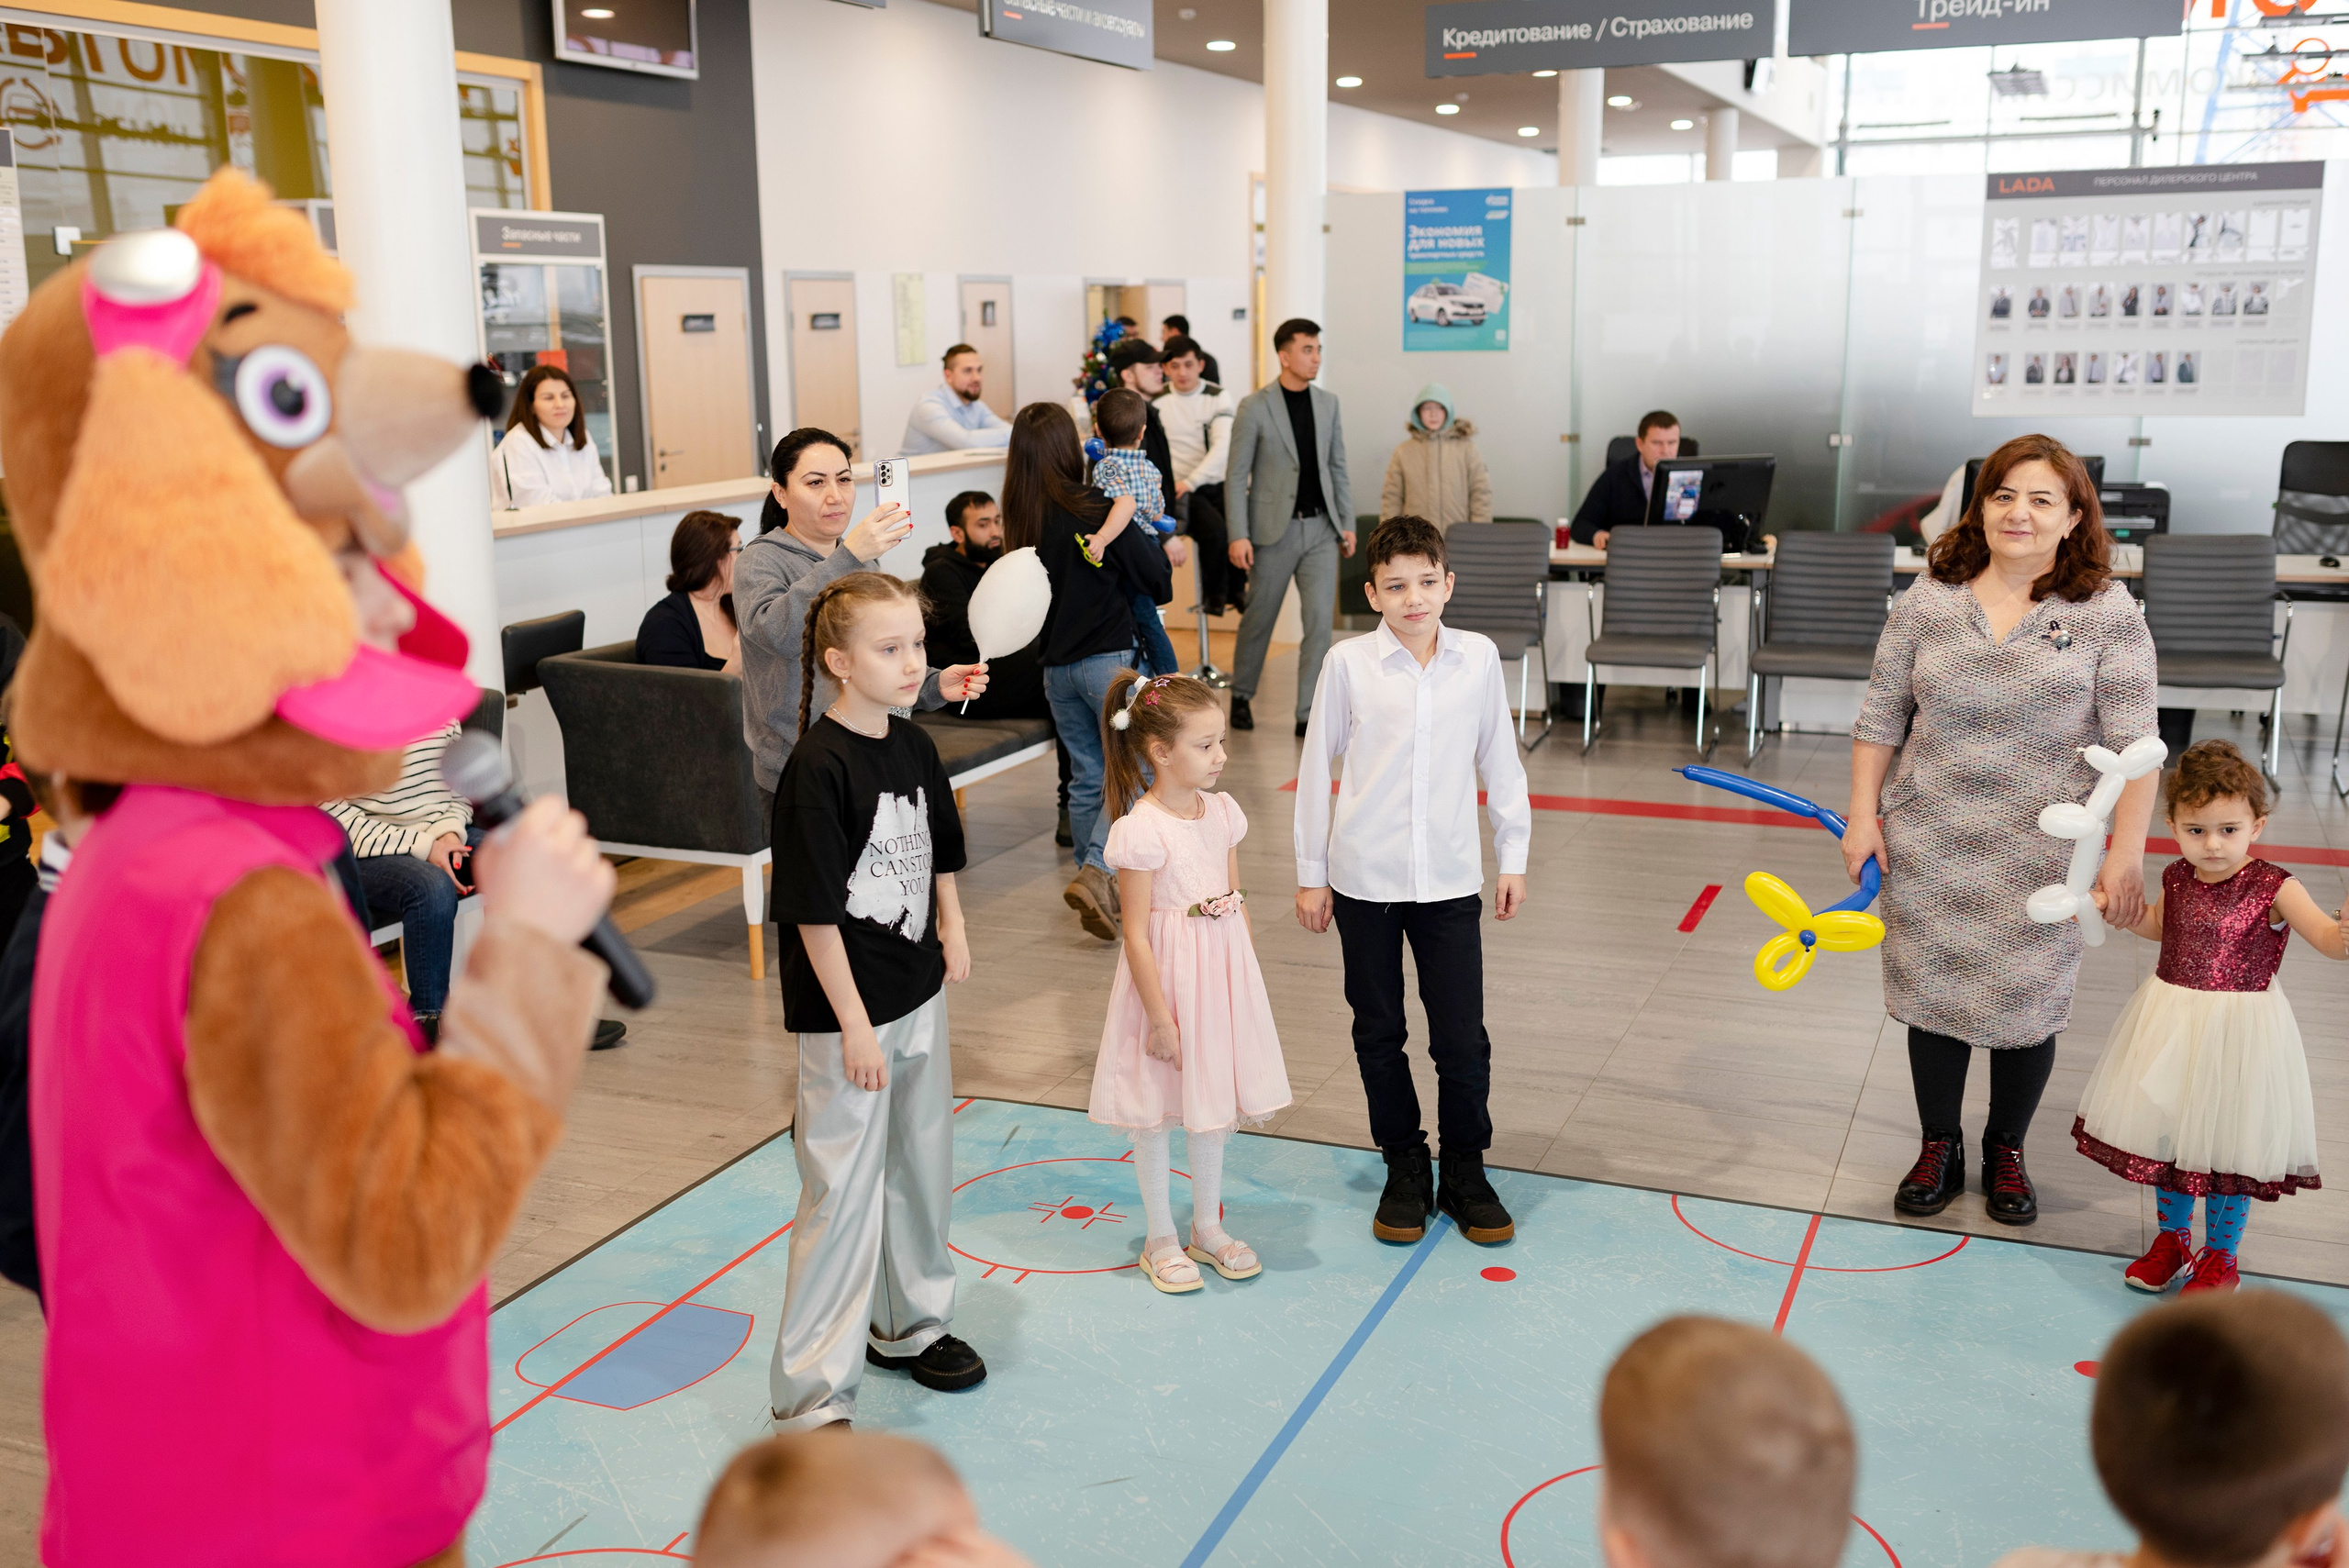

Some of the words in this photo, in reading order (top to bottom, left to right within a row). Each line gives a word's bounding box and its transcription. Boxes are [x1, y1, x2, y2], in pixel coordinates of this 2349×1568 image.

[1442, 22, 1592, 50] Кредитование
[1610, 12, 1753, 39] Страхование
[1998, 177, 2055, 194] LADA
[2093, 174, 2148, 187] ПЕРСОНАЛ
[2149, 172, 2217, 186] ДИЛЕРСКОГО
[2218, 171, 2259, 183] ЦЕНТРА
[1408, 225, 1483, 238] Экономия
[1408, 239, 1435, 251] для
[1438, 237, 1485, 249] новых
[870, 830, 930, 857] NOTHING
[899, 876, 924, 896] YOU
